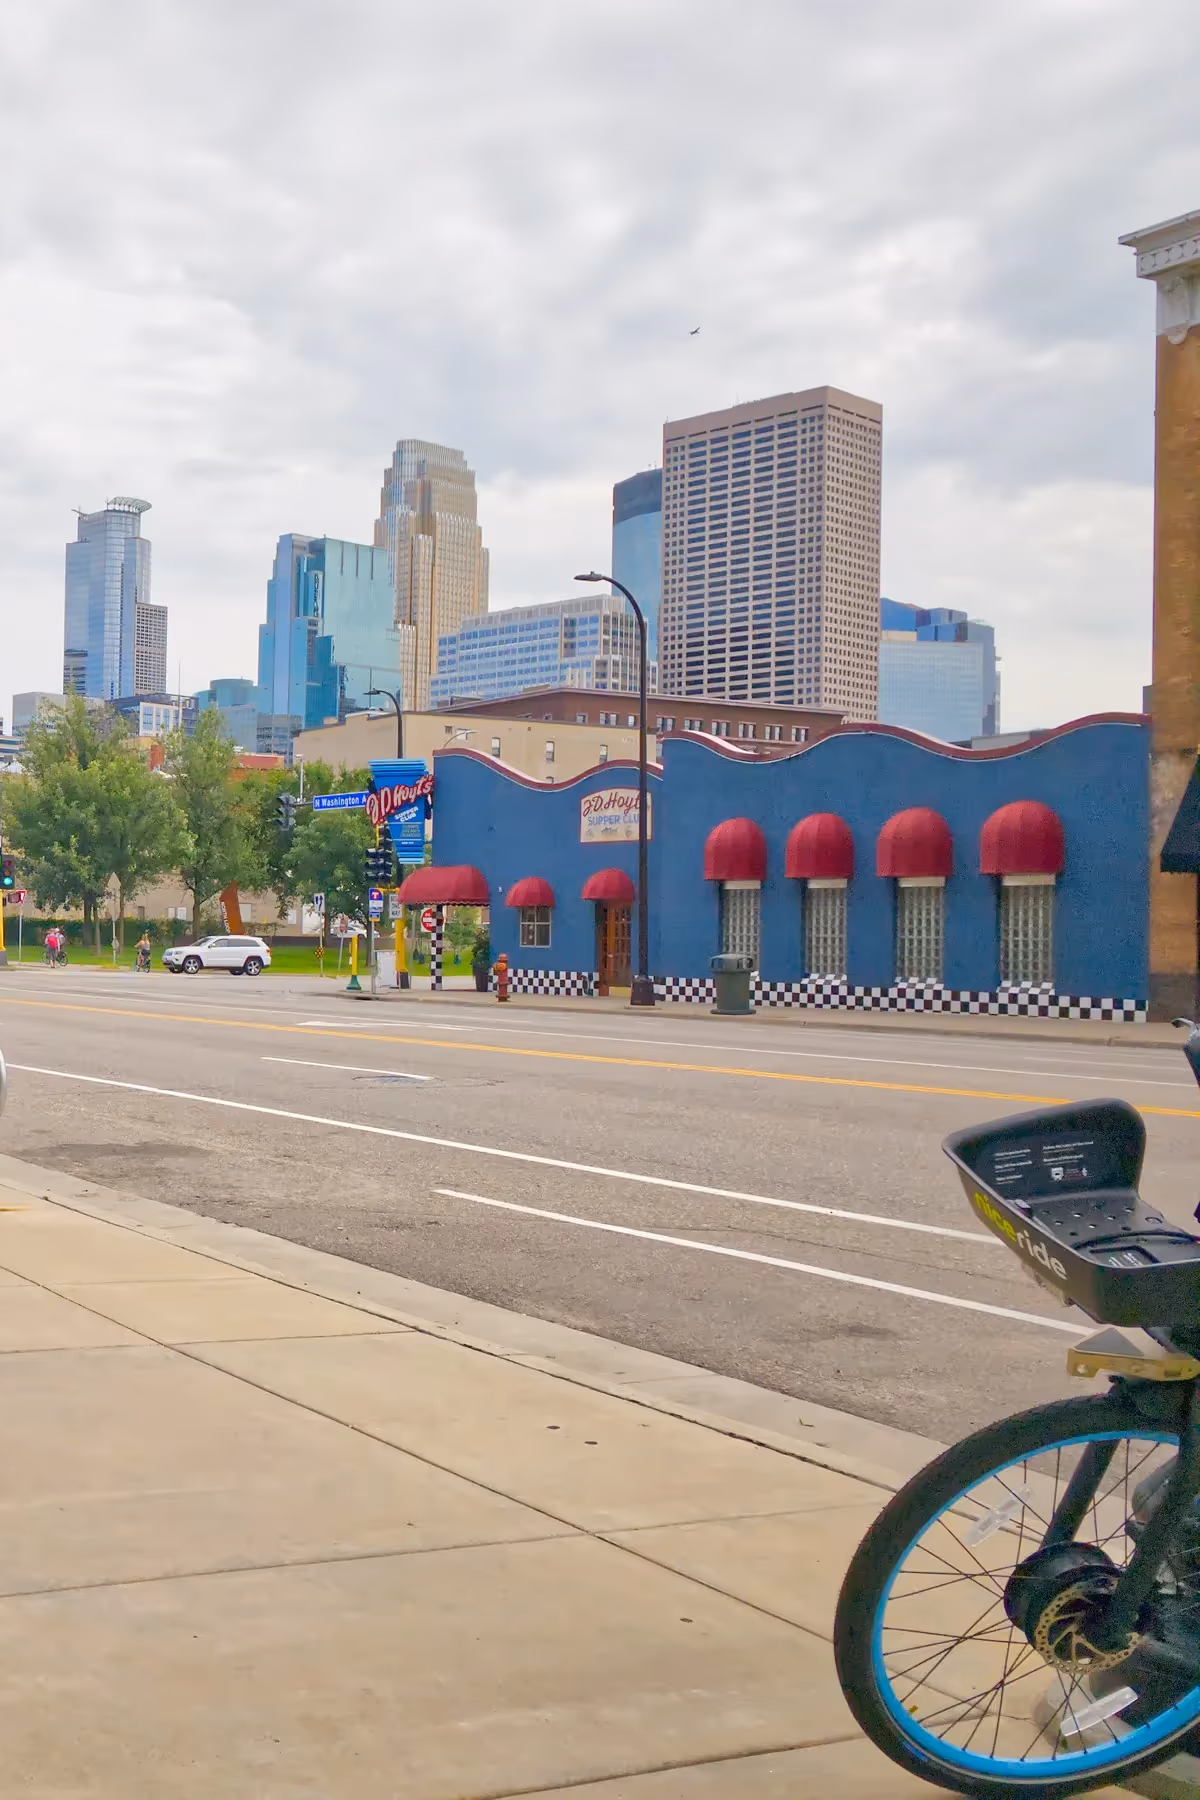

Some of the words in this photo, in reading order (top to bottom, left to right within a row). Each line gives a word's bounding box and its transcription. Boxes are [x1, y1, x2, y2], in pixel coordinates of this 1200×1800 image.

[315, 798, 320, 807] N
[321, 793, 360, 808] Washington
[362, 795, 367, 803] A
[394, 806, 419, 820] SUPPER
[400, 812, 417, 822] CLUB
[588, 815, 621, 826] SUPPER
[623, 813, 640, 825] CLU
